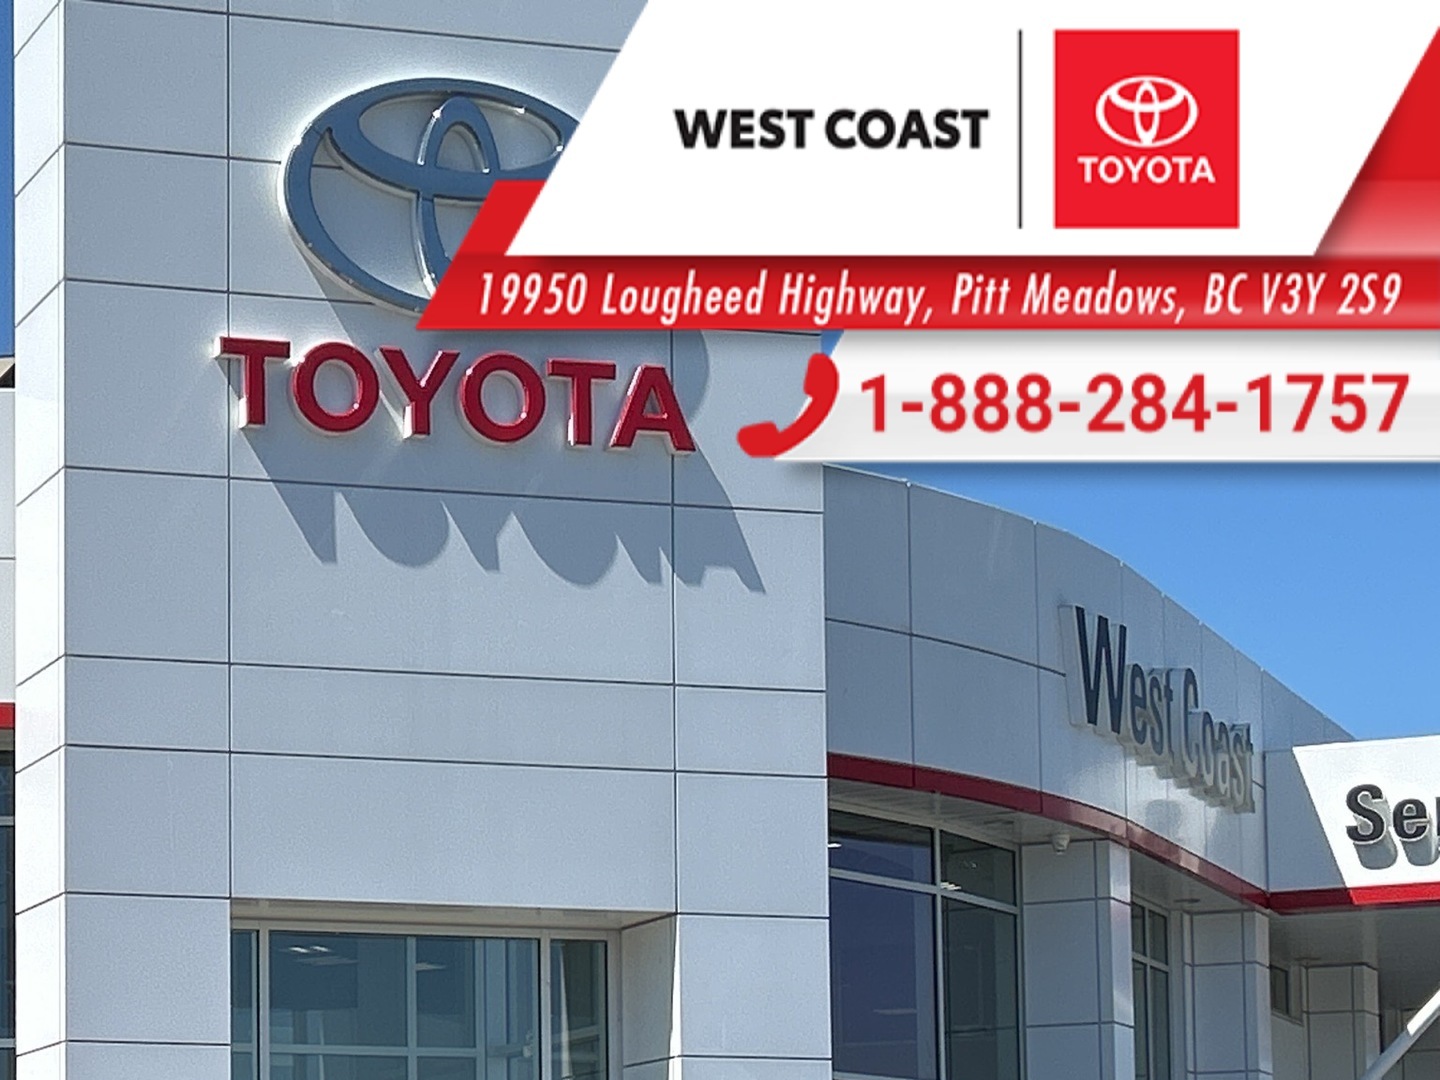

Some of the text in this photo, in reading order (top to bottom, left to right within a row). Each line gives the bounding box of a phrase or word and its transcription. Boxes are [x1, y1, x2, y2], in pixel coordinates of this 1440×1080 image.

[219, 336, 696, 453] TOYOTA
[1073, 604, 1254, 808] West Coast
[1345, 782, 1440, 843] Se
